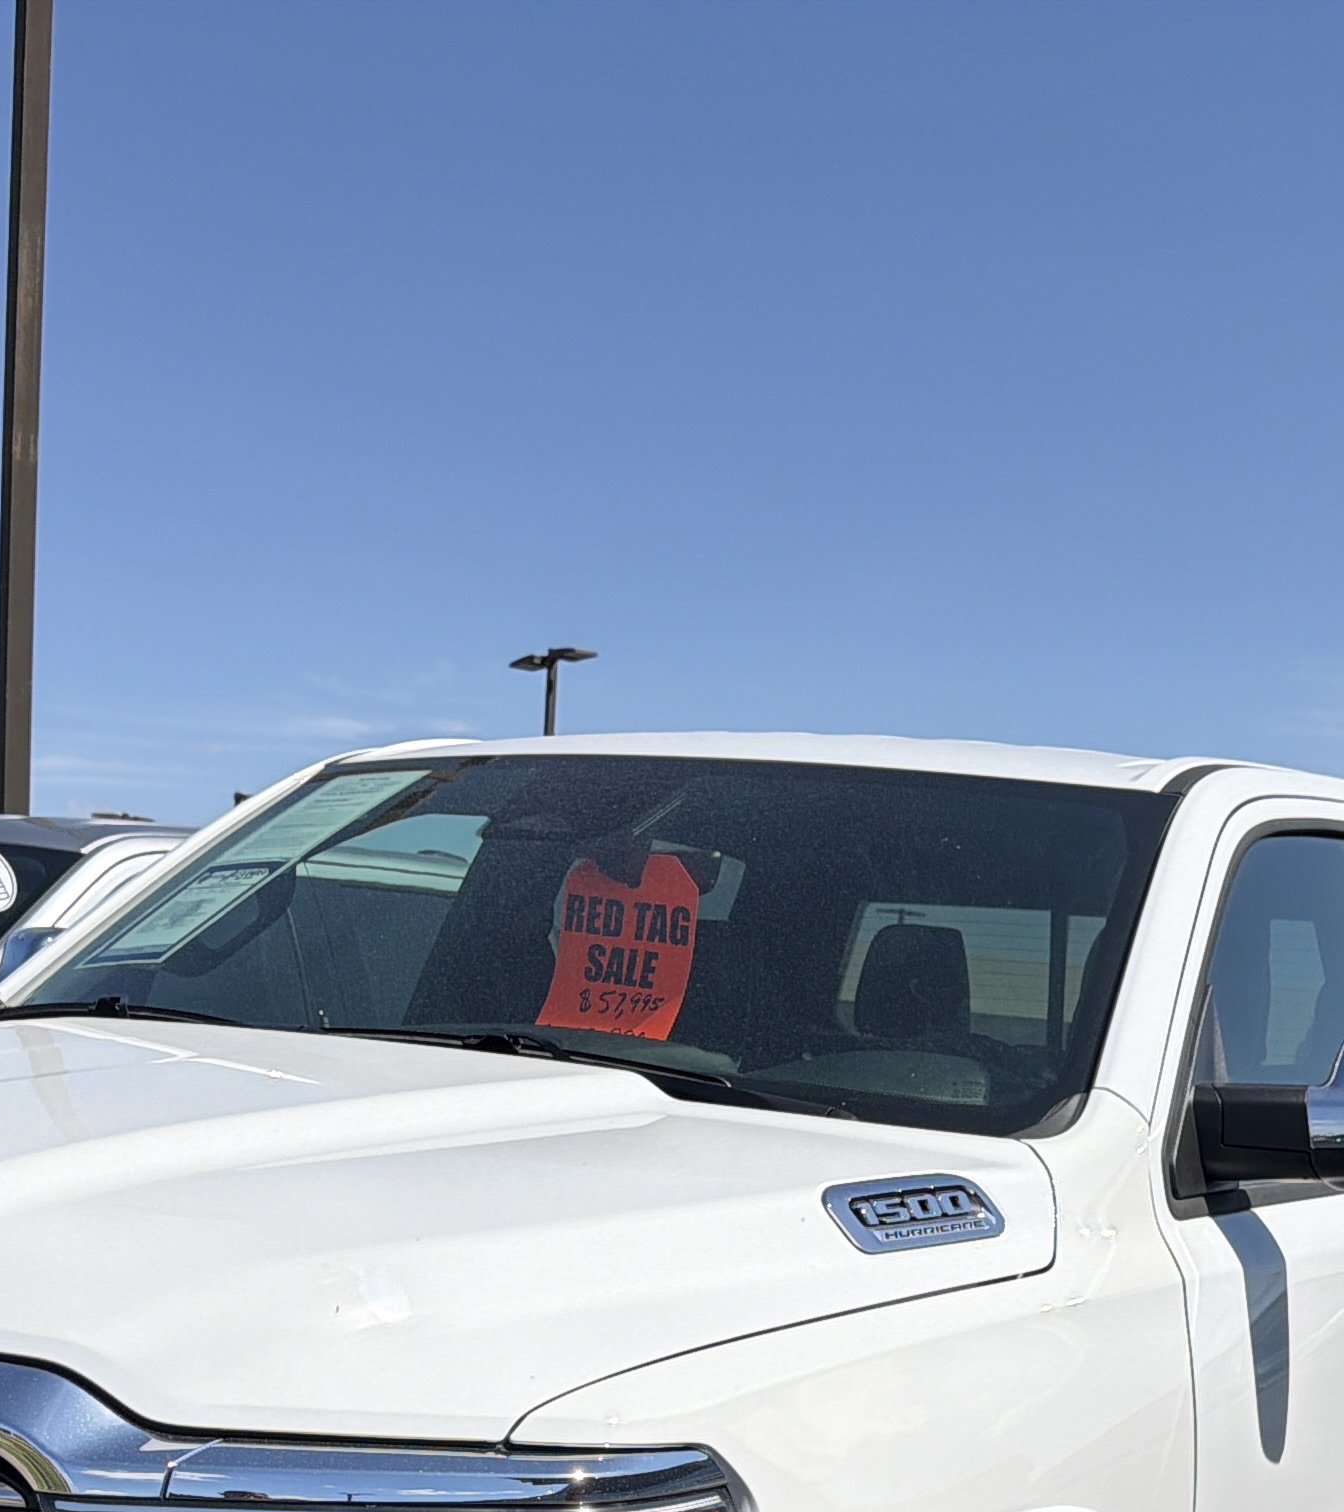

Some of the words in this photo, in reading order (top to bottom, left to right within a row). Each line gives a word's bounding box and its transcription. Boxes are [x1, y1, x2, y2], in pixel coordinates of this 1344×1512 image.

[564, 893, 625, 938] RED
[633, 901, 692, 946] TAG
[584, 943, 659, 990] SALE
[850, 1190, 972, 1226] 1500
[884, 1219, 986, 1240] HURRICANE
